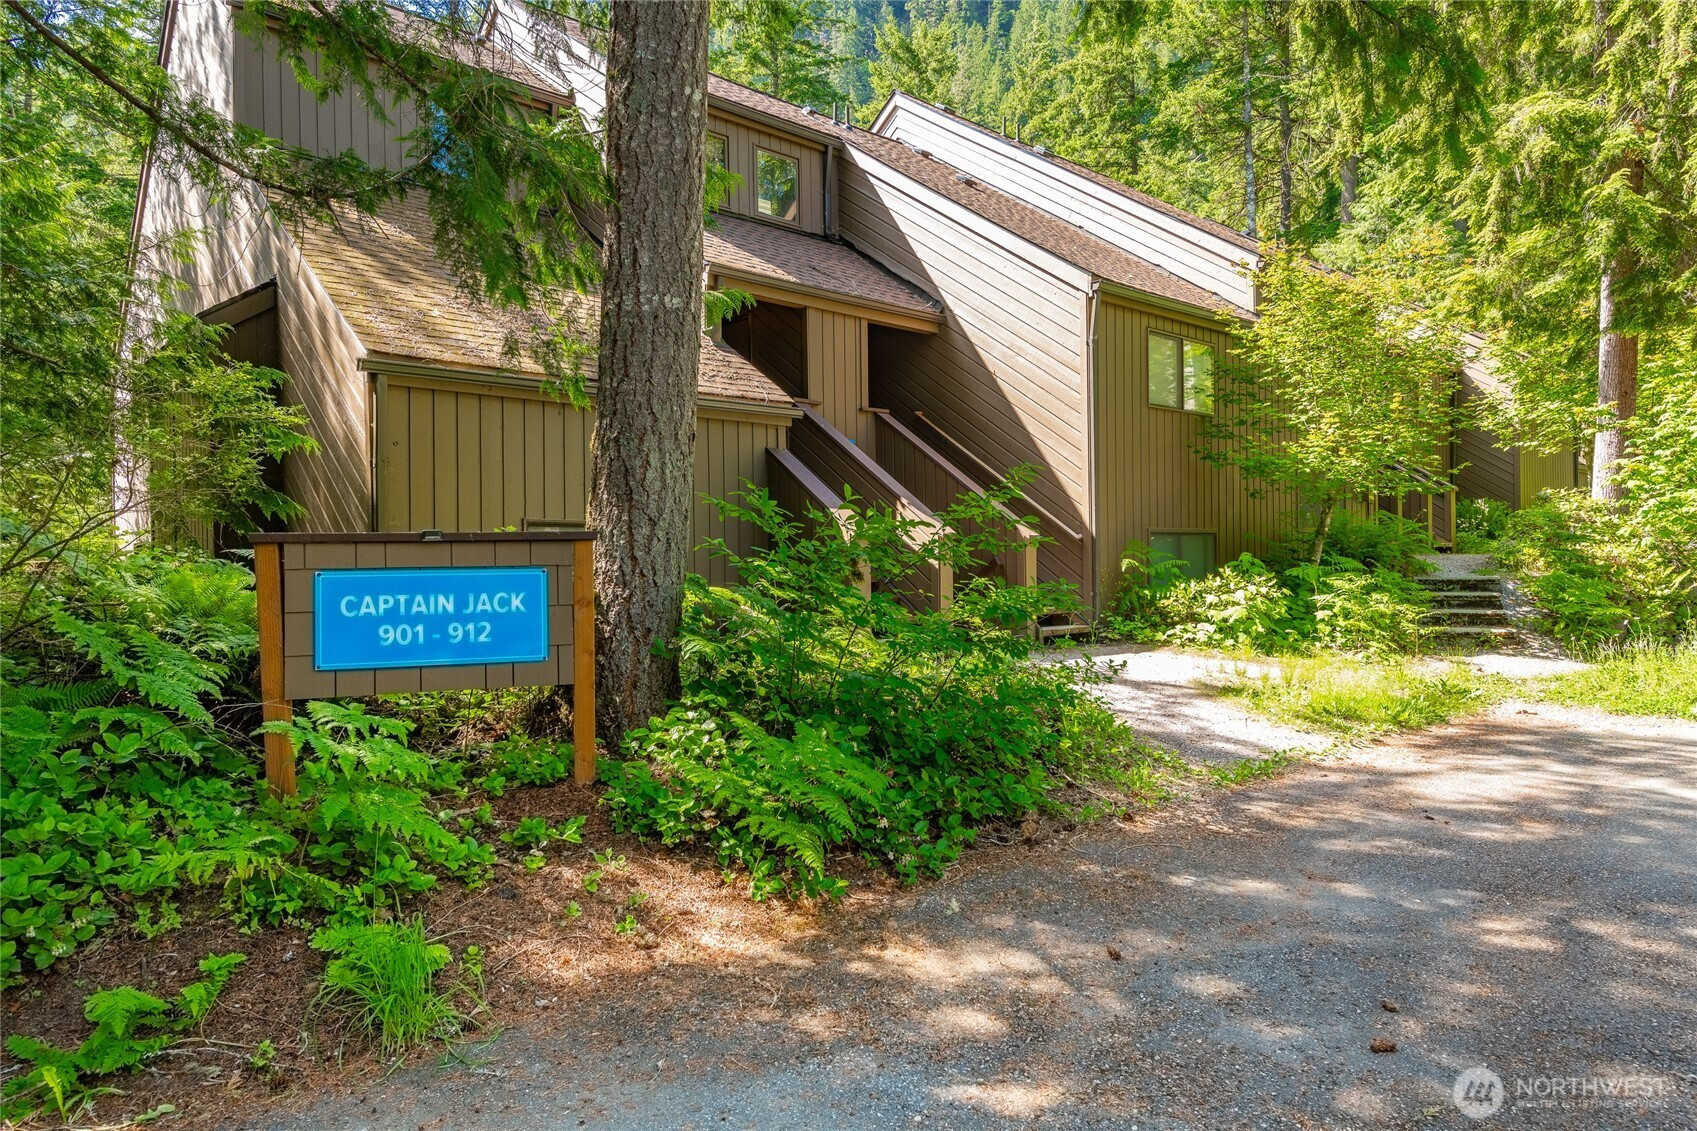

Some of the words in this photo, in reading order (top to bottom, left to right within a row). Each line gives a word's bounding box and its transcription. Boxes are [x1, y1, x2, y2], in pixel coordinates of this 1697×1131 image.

[340, 593, 454, 617] CAPTAIN
[462, 591, 526, 614] JACK
[378, 623, 424, 646] 901
[447, 621, 492, 643] 912
